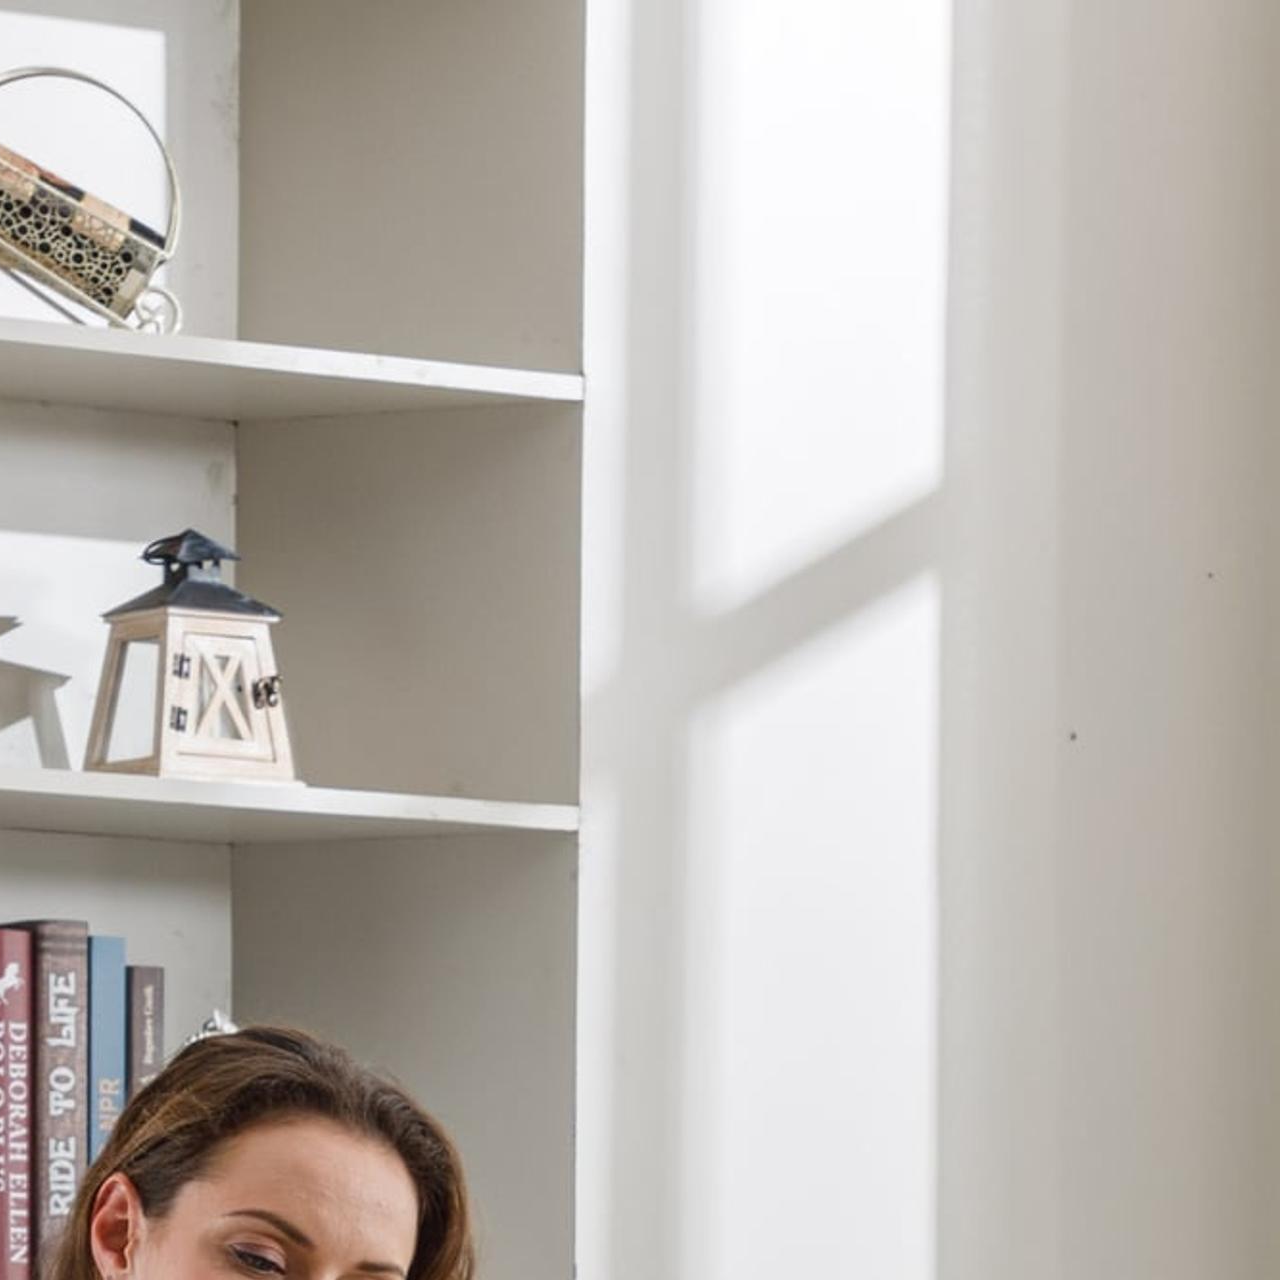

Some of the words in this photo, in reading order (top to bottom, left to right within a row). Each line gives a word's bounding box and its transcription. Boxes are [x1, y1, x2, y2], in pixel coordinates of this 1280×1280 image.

[47, 971, 79, 1047] LIFE
[7, 1021, 28, 1161] DEBORAH
[48, 1066, 76, 1116] TO
[49, 1137, 76, 1216] RIDE
[9, 1173, 30, 1264] ELLEN
